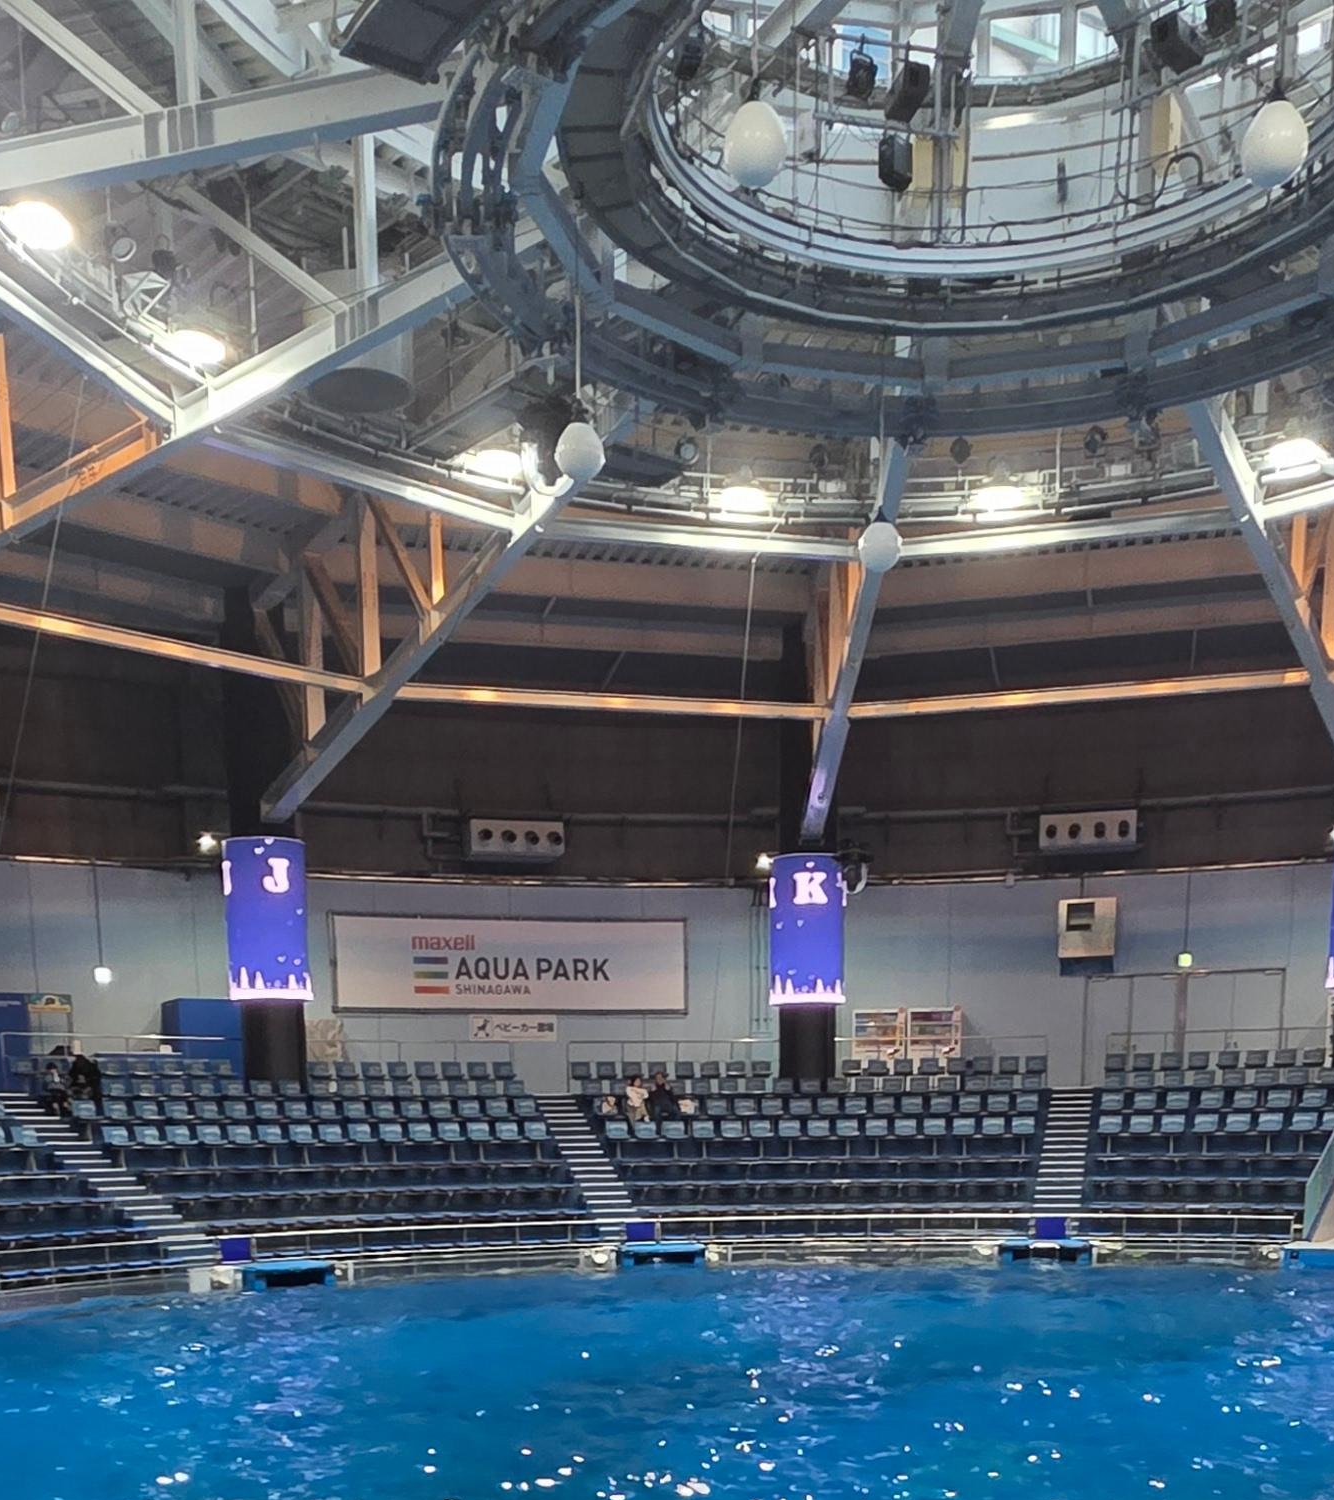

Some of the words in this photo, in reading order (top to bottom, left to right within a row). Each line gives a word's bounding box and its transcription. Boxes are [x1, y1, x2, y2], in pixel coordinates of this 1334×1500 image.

[262, 856, 291, 894] J
[792, 871, 829, 906] K
[411, 934, 476, 951] maxell
[455, 956, 530, 981] AQUA
[536, 958, 611, 982] PARK
[455, 983, 531, 996] SHINAGAWA
